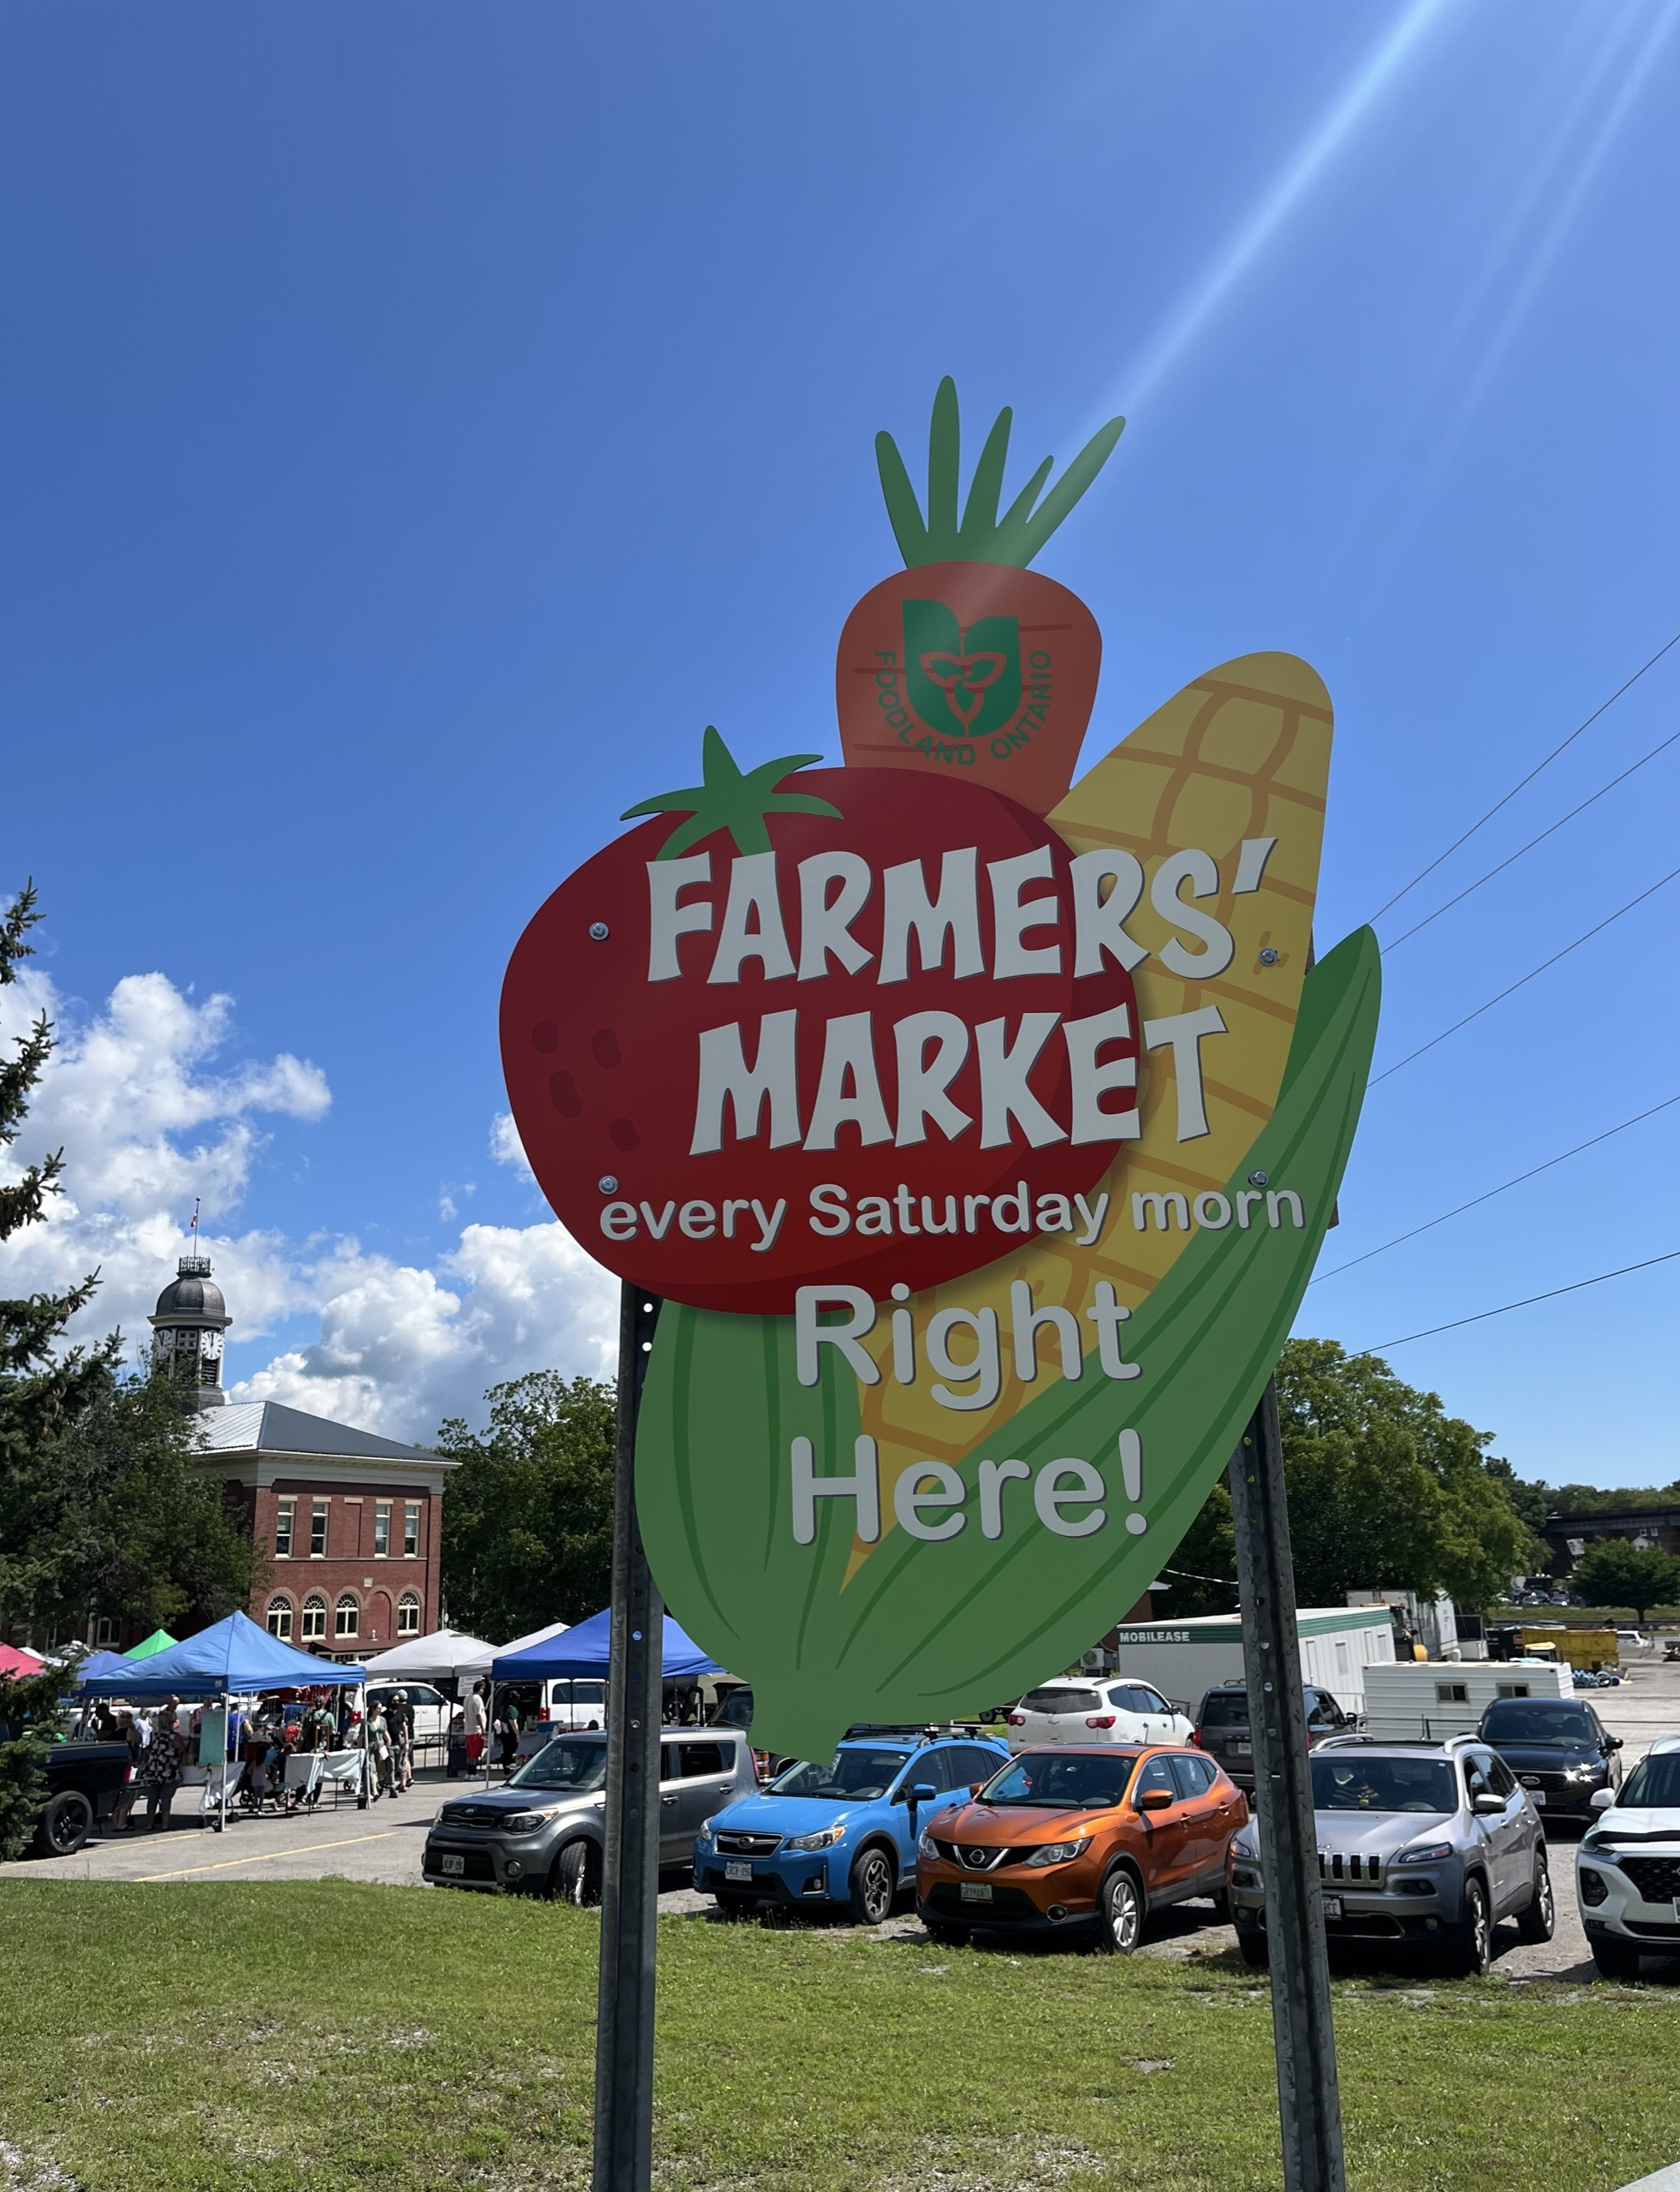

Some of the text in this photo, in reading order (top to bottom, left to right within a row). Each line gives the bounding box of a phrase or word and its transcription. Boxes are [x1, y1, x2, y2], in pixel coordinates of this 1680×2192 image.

[874, 650, 1051, 765] FOODLAND ONTARIO
[646, 837, 1278, 986] FARMERS'
[688, 1002, 1227, 1156] MARKET
[600, 1181, 1304, 1252] every Saturday morn
[795, 1280, 1142, 1411] Right
[790, 1428, 1147, 1545] Here!
[1119, 1631, 1189, 1642] MOBILEASE
